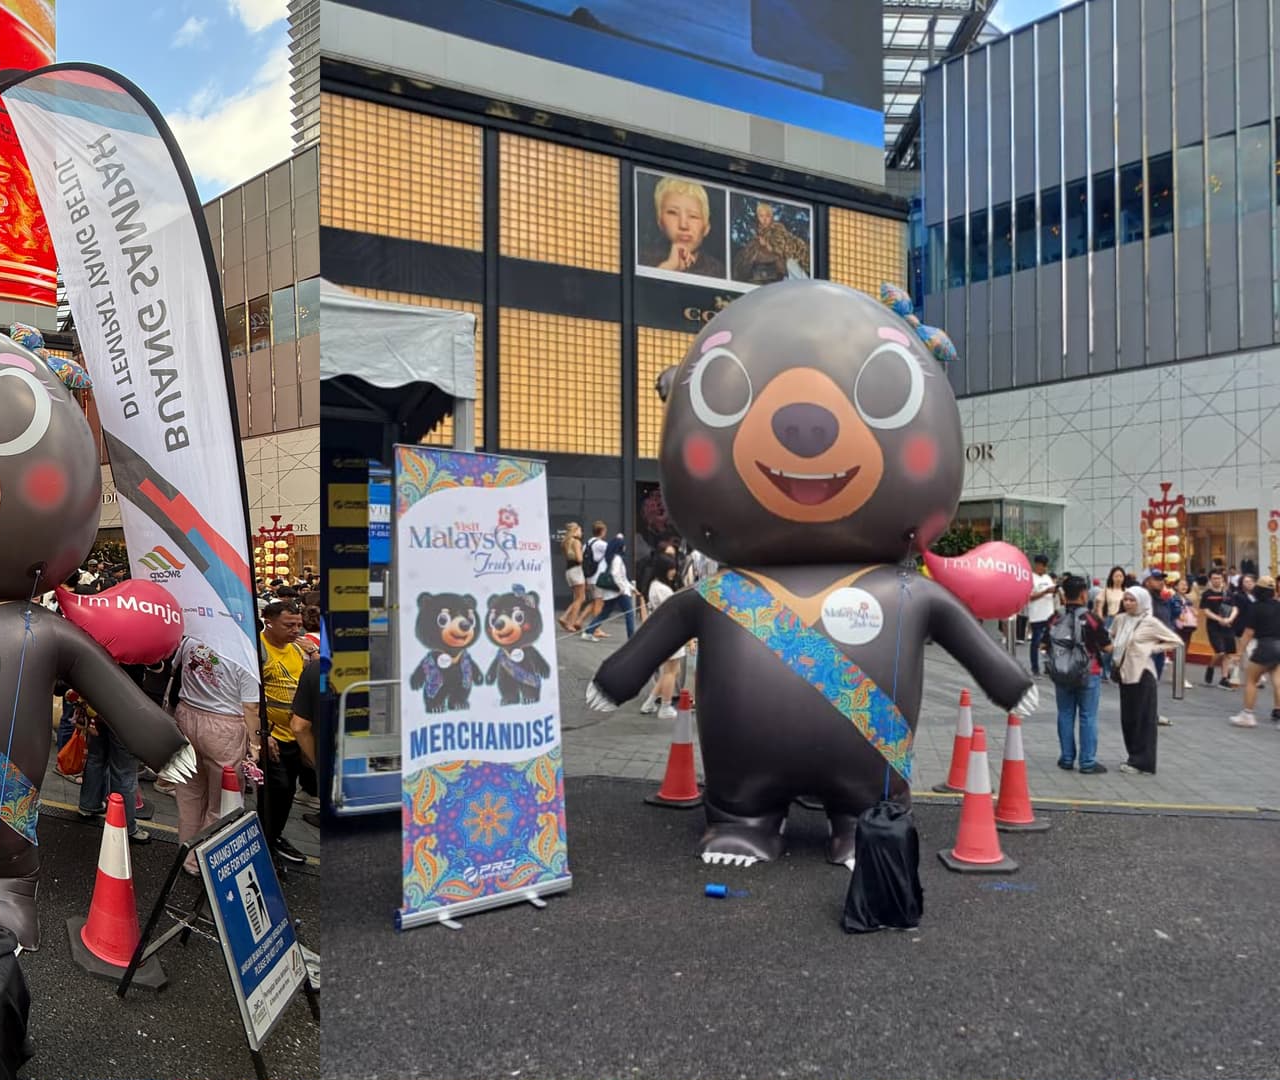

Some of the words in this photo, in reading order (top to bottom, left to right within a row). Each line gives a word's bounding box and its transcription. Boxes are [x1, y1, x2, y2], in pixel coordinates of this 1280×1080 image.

[966, 442, 994, 462] OR
[102, 493, 117, 504] DI
[409, 525, 518, 552] Malaysia
[455, 521, 480, 531] Visit
[474, 550, 513, 578] Truly
[517, 560, 542, 572] Asia
[976, 557, 1030, 582] Manja
[76, 594, 109, 607] I'm
[116, 596, 181, 626] Manja
[410, 715, 554, 760] MERCHANDISE
[480, 859, 515, 874] PRO
